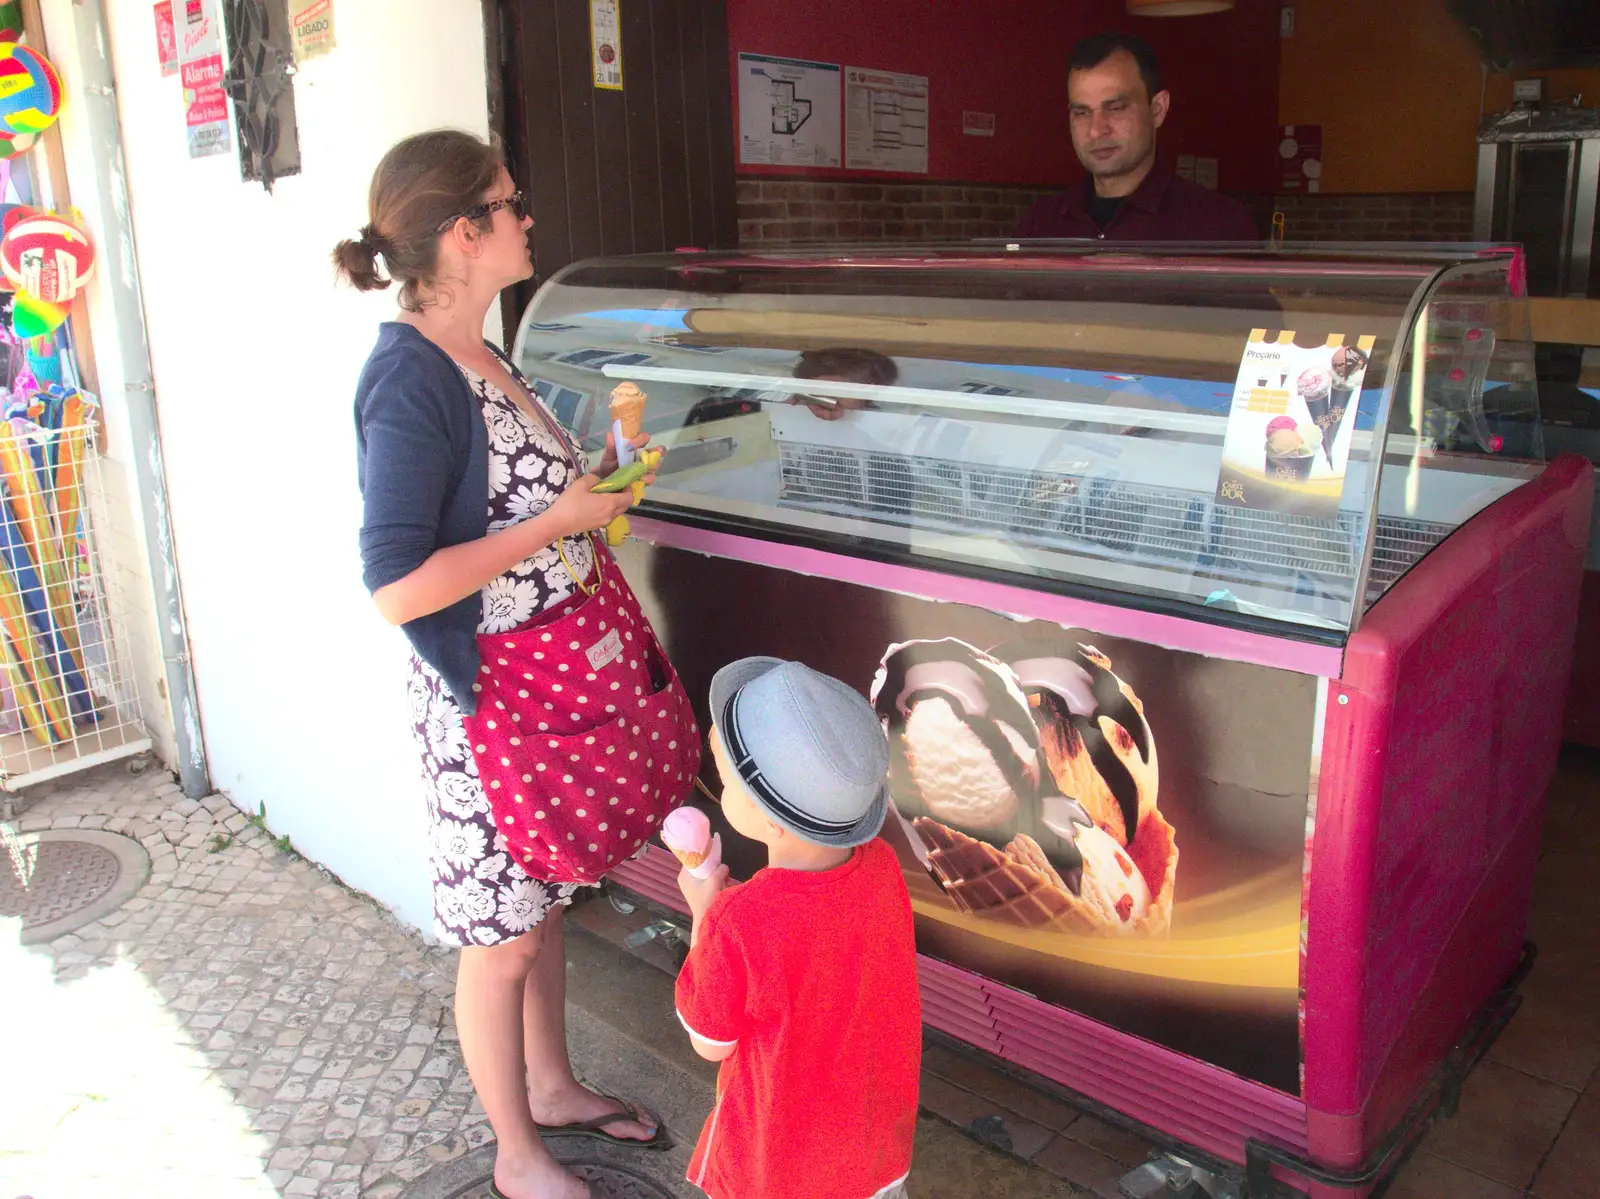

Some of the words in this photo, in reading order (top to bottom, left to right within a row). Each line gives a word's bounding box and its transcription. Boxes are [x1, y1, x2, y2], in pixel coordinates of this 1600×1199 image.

[298, 20, 329, 37] LIGADO
[185, 64, 221, 84] Alarme
[1247, 349, 1281, 361] Preçário
